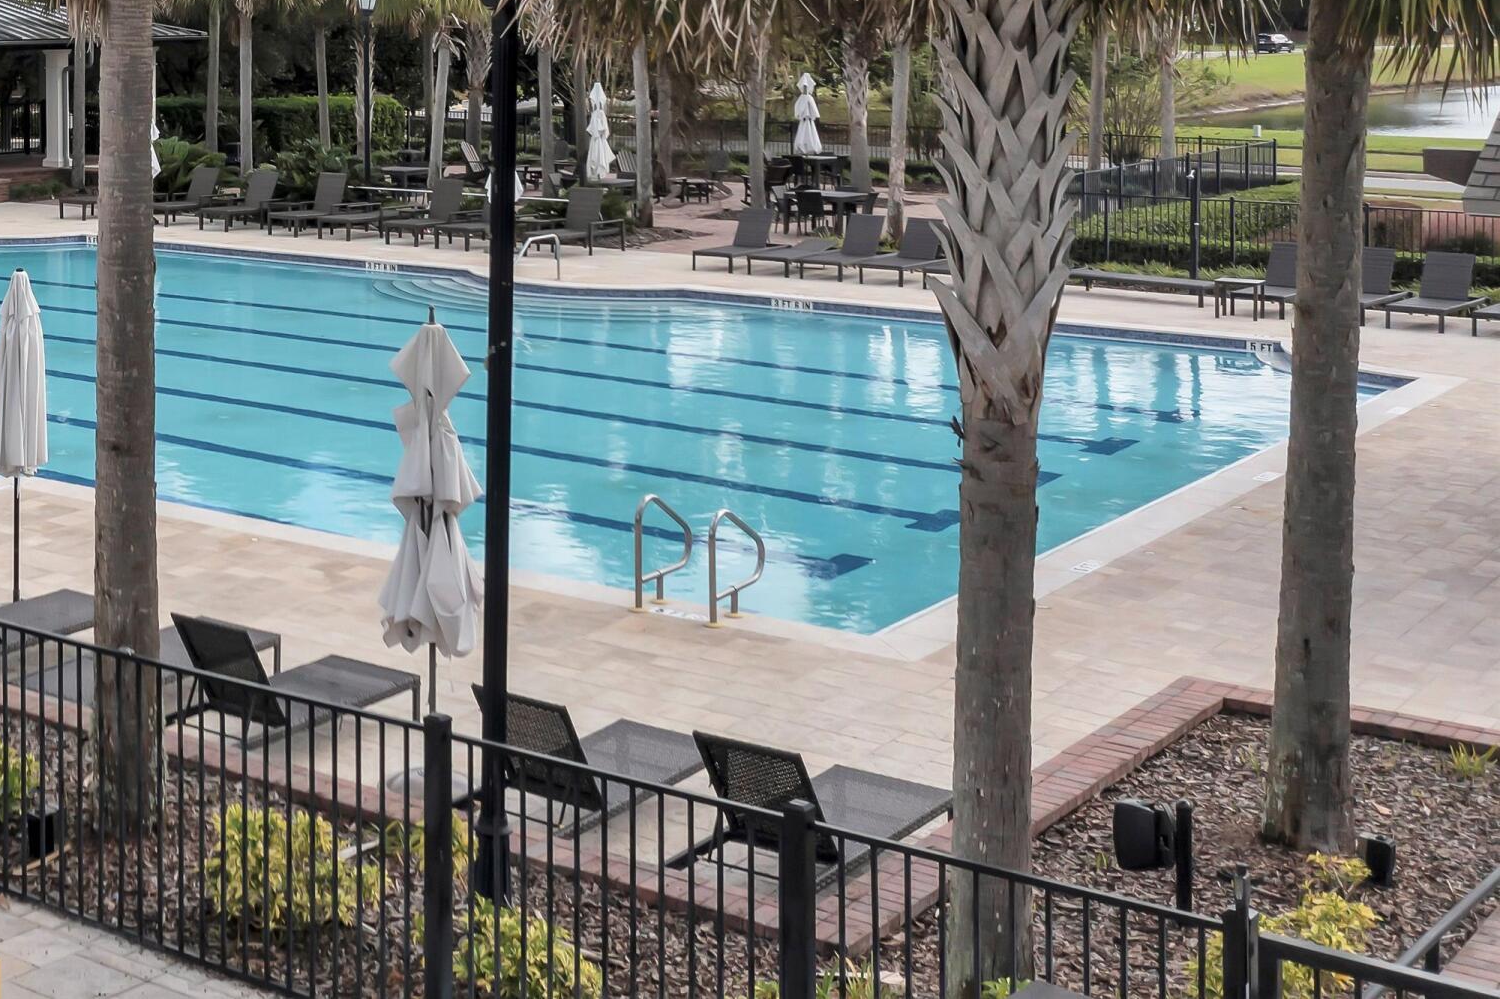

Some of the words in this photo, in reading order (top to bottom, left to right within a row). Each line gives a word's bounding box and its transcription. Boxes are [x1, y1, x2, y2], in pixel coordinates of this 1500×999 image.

[782, 300, 790, 308] FT
[802, 301, 811, 310] IN
[1250, 342, 1256, 351] 5
[1260, 343, 1272, 352] FT
